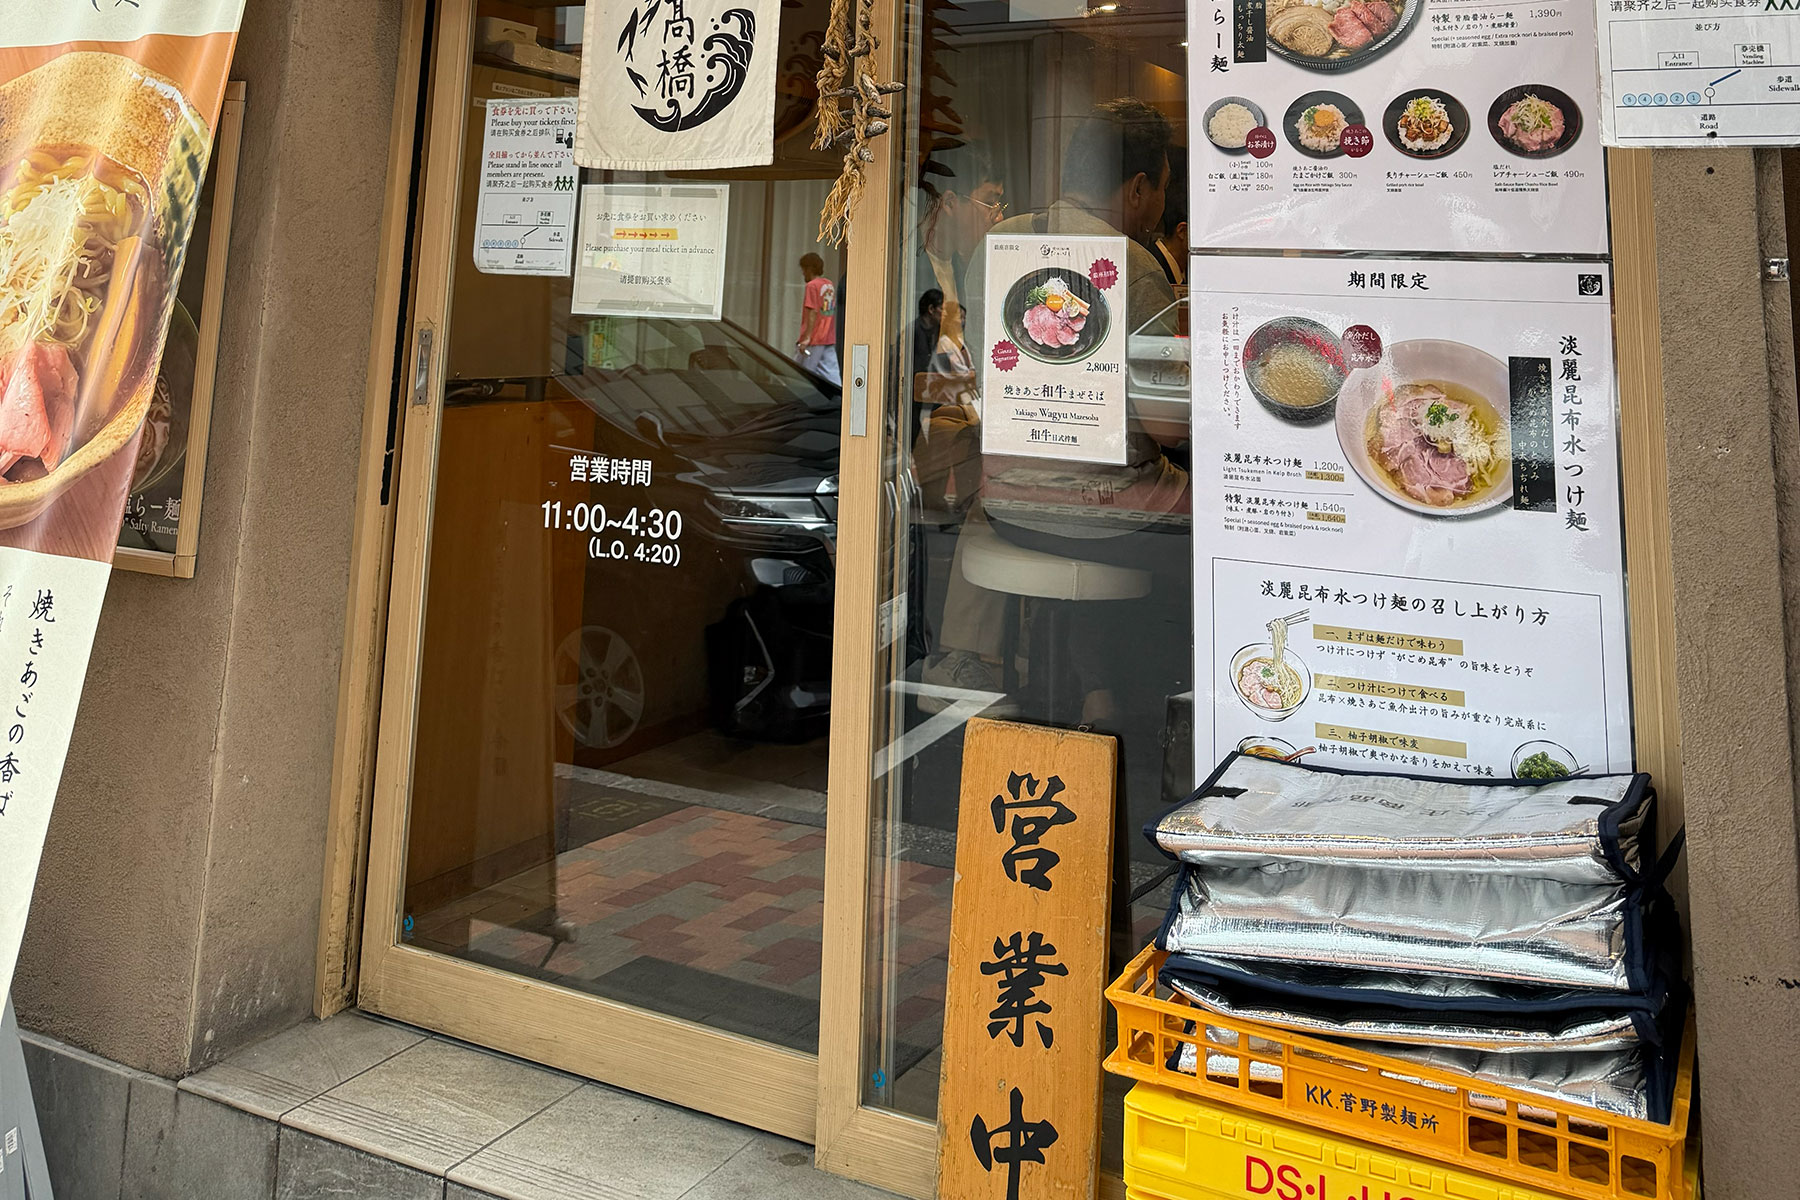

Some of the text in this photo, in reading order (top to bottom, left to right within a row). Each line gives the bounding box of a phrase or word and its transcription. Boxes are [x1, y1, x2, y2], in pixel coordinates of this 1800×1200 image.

[1431, 9, 1562, 24] 特製 背脂醤油らー麺 1,390円
[491, 117, 575, 129] Please buy your tickets first.
[1247, 139, 1274, 149] お茶漬け
[487, 161, 504, 169] Please
[554, 160, 562, 168] all
[486, 170, 512, 178] members
[522, 171, 545, 180] present.
[1208, 172, 1226, 180] 白ご飯
[1386, 171, 1448, 179] 炙りチャーシューご飯
[1564, 170, 1584, 178] 490円
[596, 212, 706, 222] お先に食券をお買い求めください
[585, 243, 602, 252] Please
[603, 244, 629, 254] purchase
[630, 246, 644, 255] your
[646, 245, 660, 253] meal
[662, 245, 679, 253] ticket
[688, 246, 715, 254] advance
[1347, 271, 1430, 291] 期間限定
[1086, 362, 1119, 373] 2,800円
[1004, 384, 1105, 401] 焼きあご和牛まぜそば
[1014, 408, 1099, 421] Yakiago Wagyu Mazesoba
[1559, 335, 1590, 532] 淡麗昆布水つけ麺
[569, 455, 652, 486] 営業時間
[1224, 453, 1344, 472] 淡麗昆布水つけ麺 1,200円
[1238, 467, 1265, 475] Tsukemen
[1224, 493, 1345, 513] 特製 淡麗昆布水つけ麺 1,540円
[130, 518, 148, 535] Salty
[151, 521, 178, 535] Ramen
[541, 501, 682, 540] 11:00~4:30
[589, 536, 681, 567] (L.O. 4:20)
[1260, 579, 1550, 626] 淡麗昆布水つけ麺の召し上がり方
[1326, 630, 1446, 651] 一、まずは麺だけで味わう
[1327, 678, 1448, 702] 二、つけ汁につけて食べる
[1328, 728, 1420, 750] 三、柚子胡椒で味変
[1318, 742, 1495, 777] 柚子胡椒で爽やかな香りを加えて味変
[970, 769, 1077, 1200] 営業中
